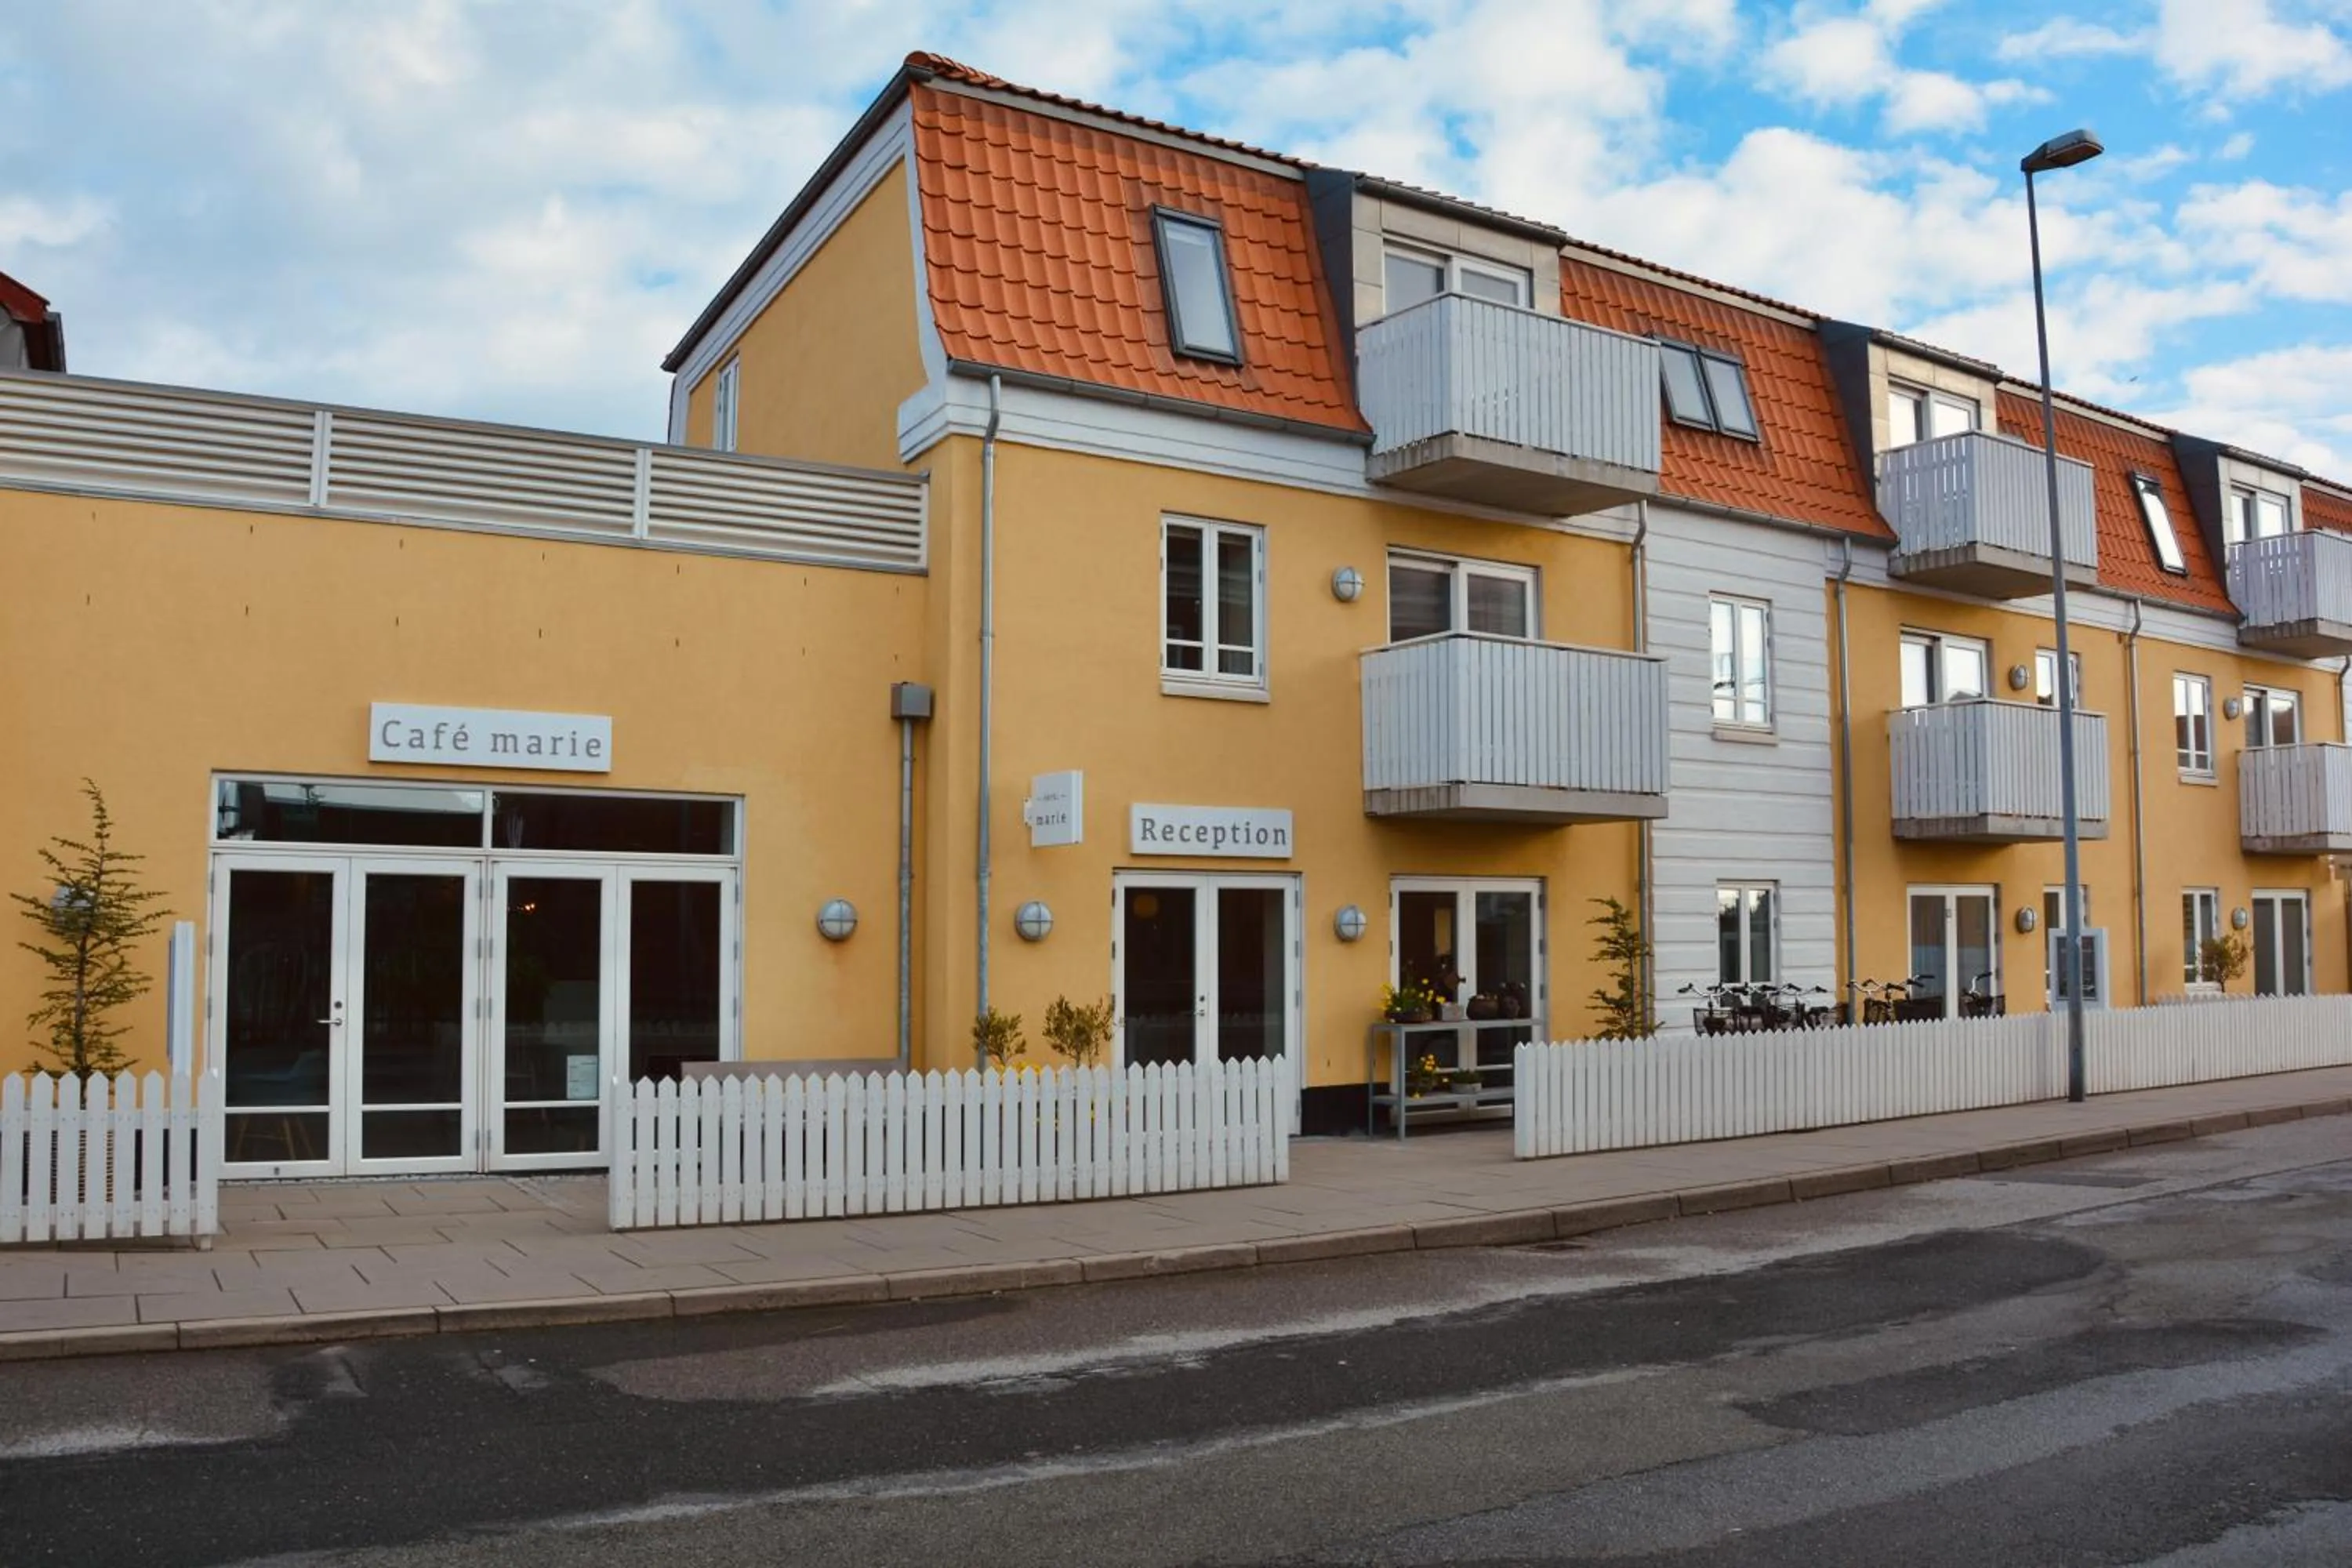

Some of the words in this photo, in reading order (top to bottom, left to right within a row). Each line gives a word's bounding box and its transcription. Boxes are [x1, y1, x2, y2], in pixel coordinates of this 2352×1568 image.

[381, 720, 470, 750] Café
[490, 731, 602, 758] marie
[1140, 818, 1287, 849] Reception
